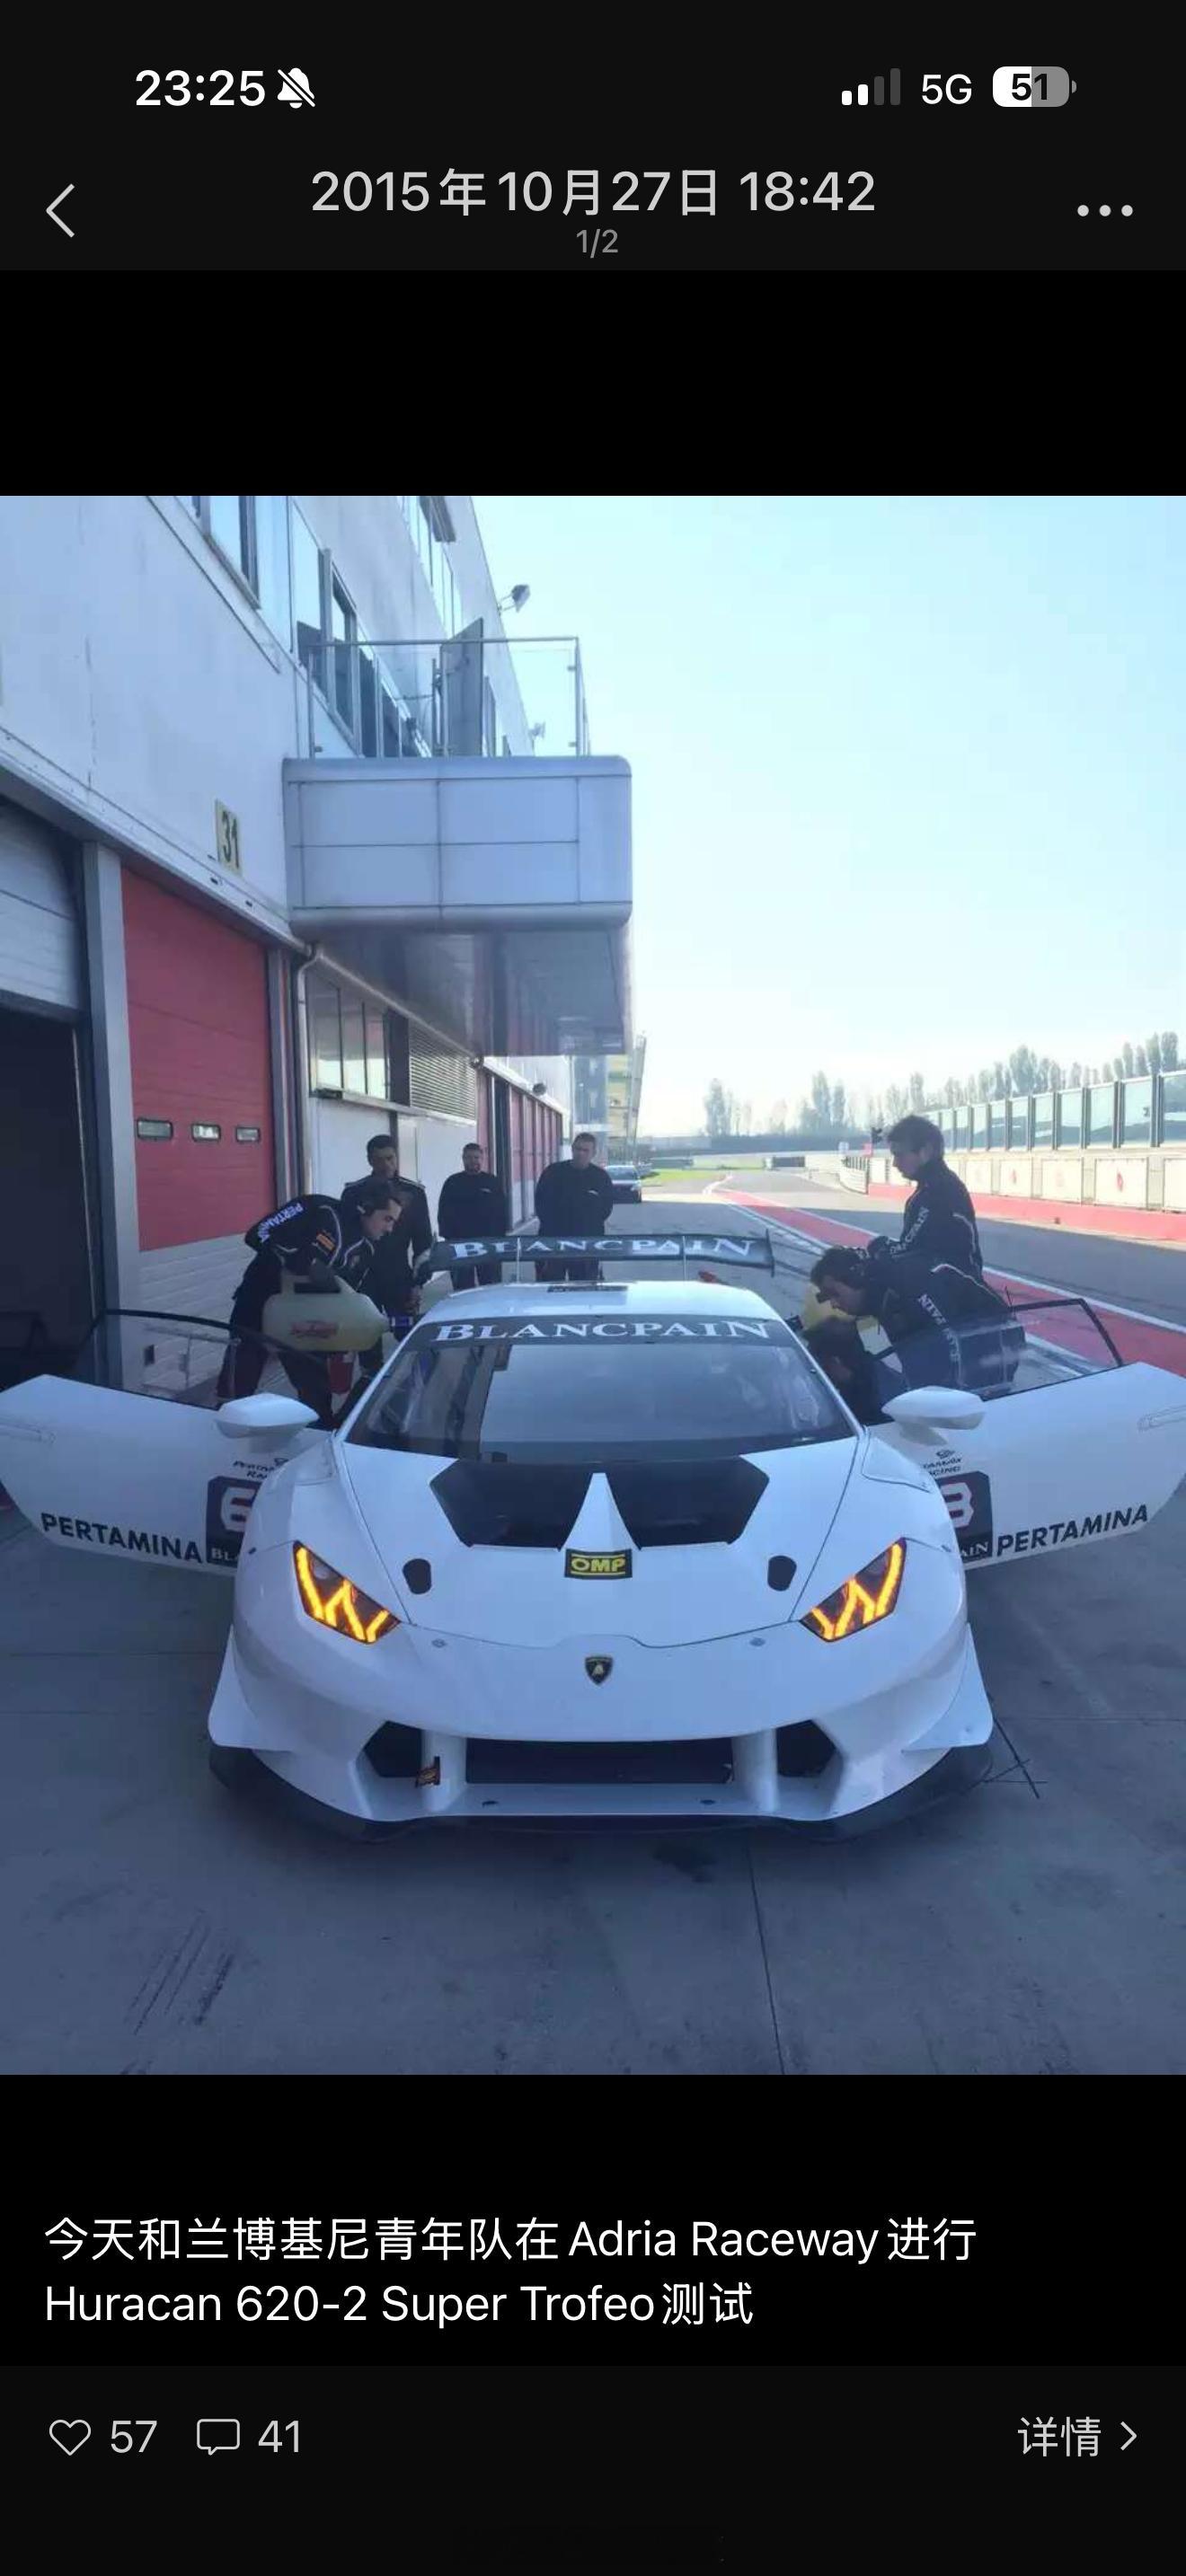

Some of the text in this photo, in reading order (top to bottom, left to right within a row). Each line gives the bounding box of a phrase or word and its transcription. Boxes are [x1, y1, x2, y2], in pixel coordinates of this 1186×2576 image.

[221, 810, 240, 869] 31
[451, 1237, 754, 1259] BLANCPAIN
[435, 1320, 771, 1342] BLANCPAIN
[40, 1512, 204, 1564] PERTAMINA
[996, 1504, 1148, 1557] PERTAMINA
[571, 1557, 626, 1573] OMP
